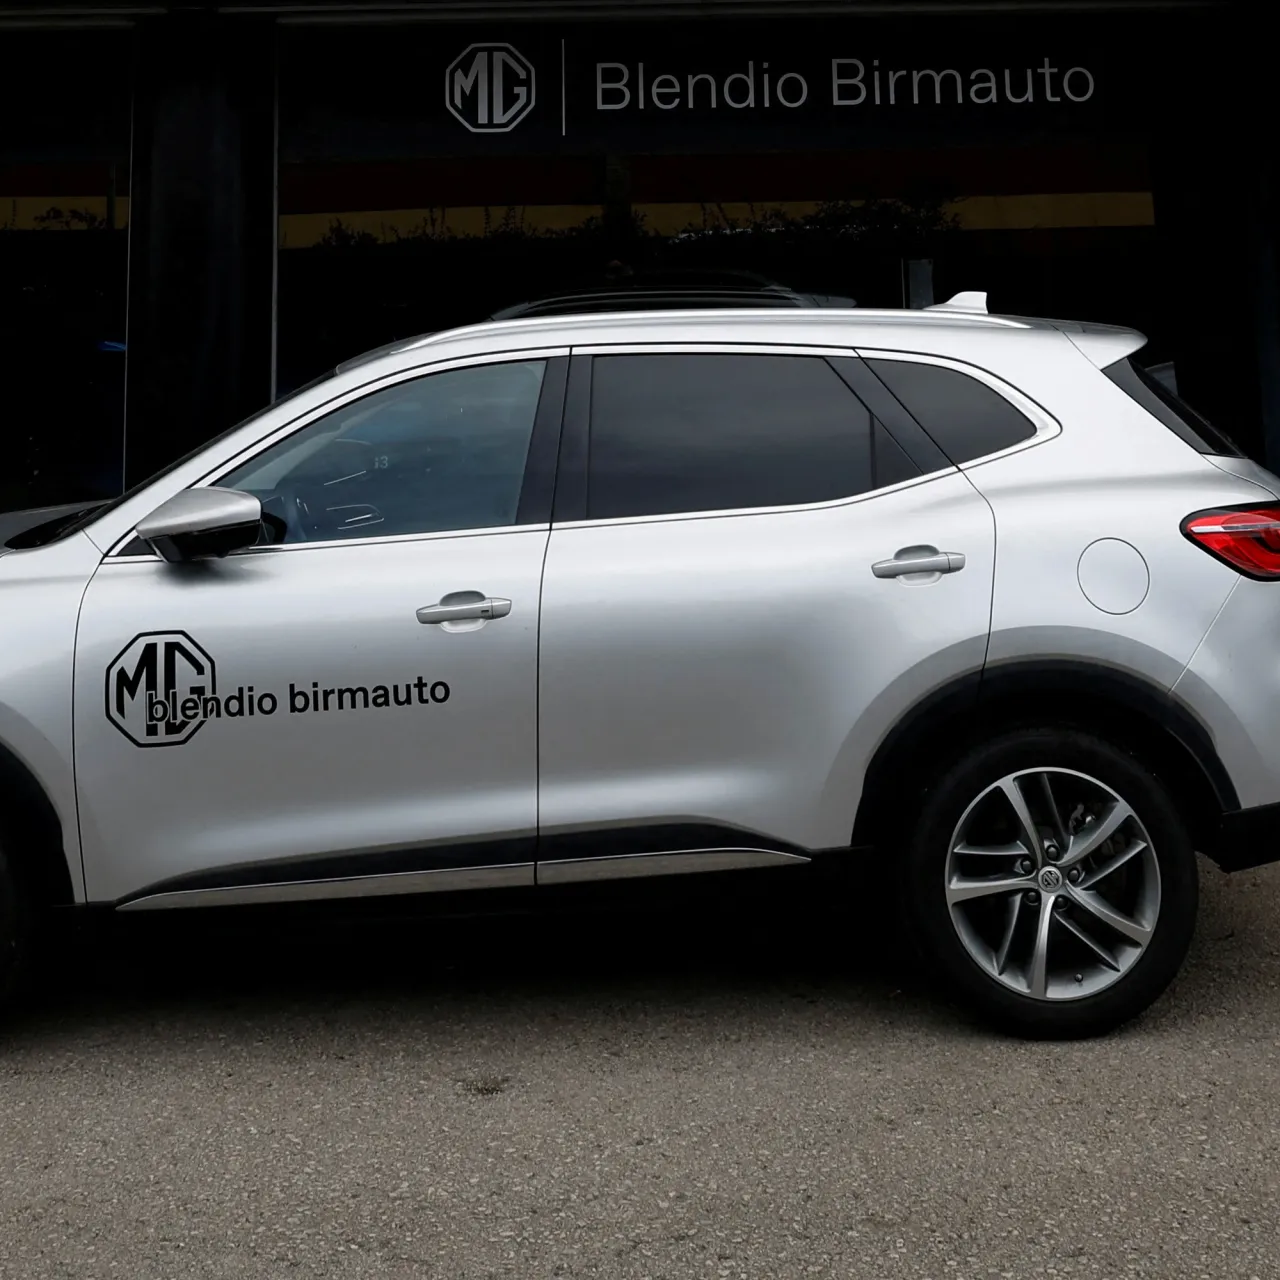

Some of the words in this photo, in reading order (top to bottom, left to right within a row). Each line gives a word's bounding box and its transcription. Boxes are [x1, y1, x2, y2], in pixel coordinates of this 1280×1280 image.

[454, 51, 528, 124] MG
[596, 60, 808, 110] Blendio
[831, 57, 1094, 106] Birmauto
[146, 686, 278, 723] blendio
[288, 676, 451, 714] birmauto
